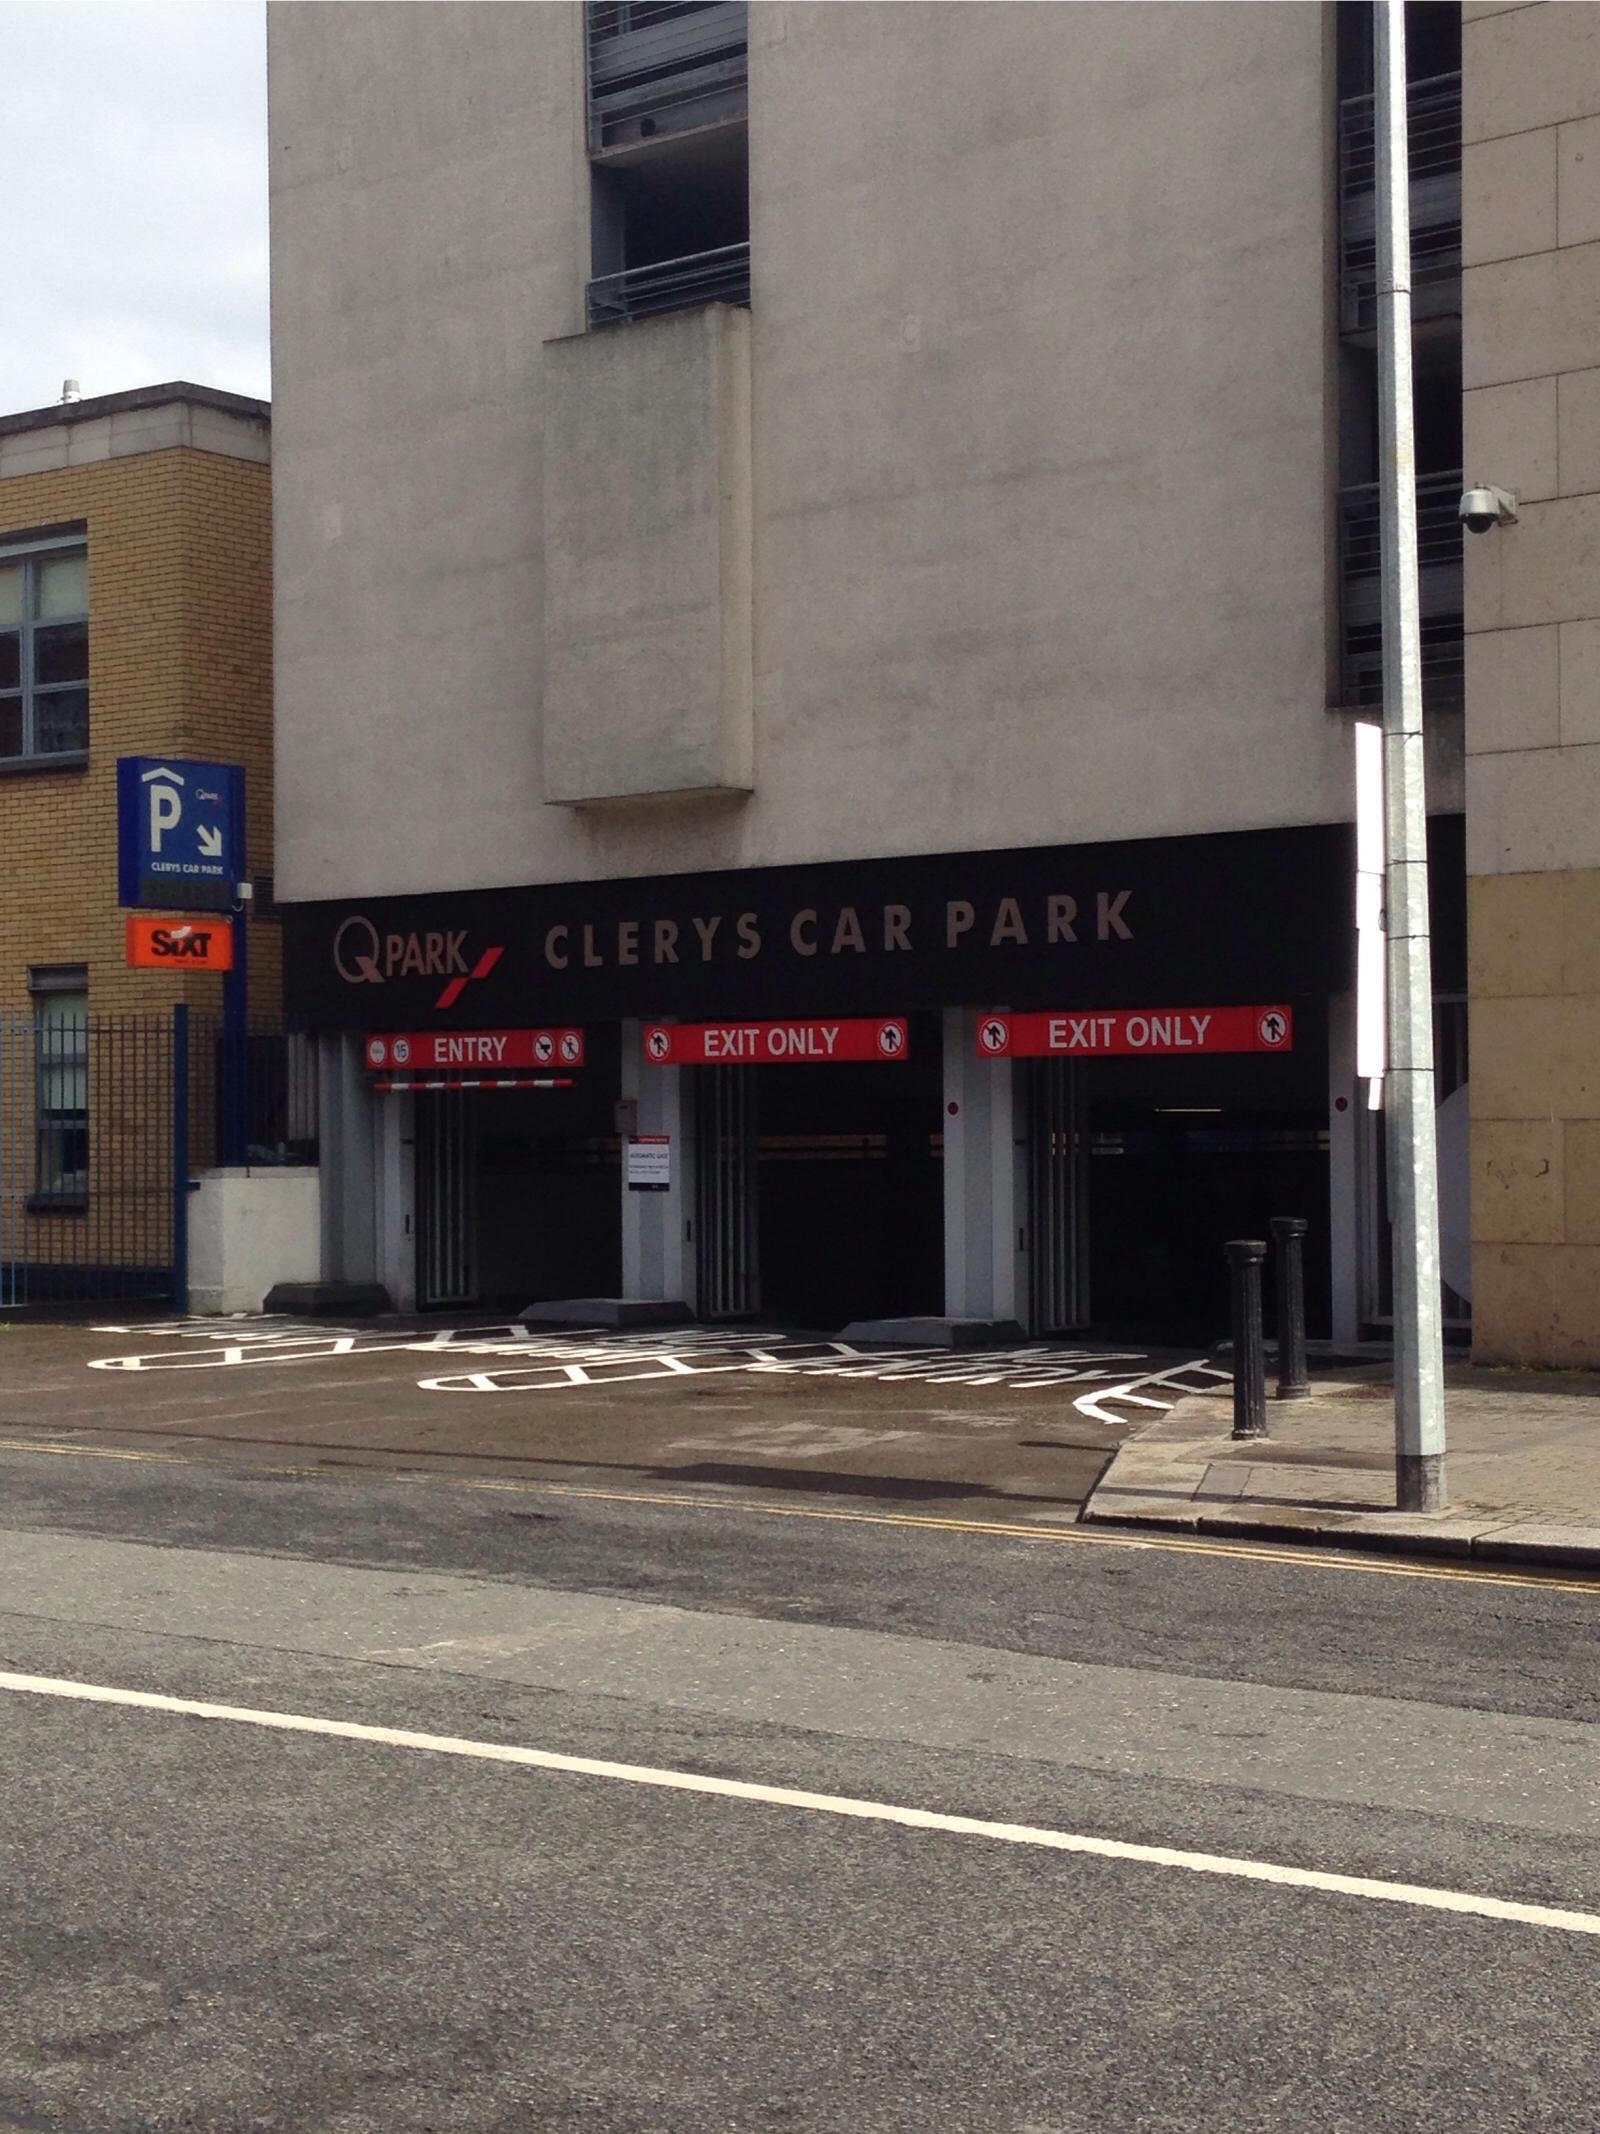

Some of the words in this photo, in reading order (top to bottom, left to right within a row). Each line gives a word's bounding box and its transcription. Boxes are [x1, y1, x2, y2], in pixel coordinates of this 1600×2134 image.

[151, 784, 182, 852] P
[183, 864, 200, 874] CAR
[201, 865, 224, 875] PARK
[545, 911, 761, 970] CLERYS
[789, 903, 914, 957] CAR
[946, 890, 1135, 949] PARK
[703, 1028, 765, 1057] EXIT
[768, 1026, 839, 1055] ONLY
[1048, 1018, 1117, 1048] EXIT
[1125, 1015, 1212, 1047] ONLY
[396, 1043, 408, 1059] 15
[434, 1036, 507, 1062] ENTRY
[929, 1347, 1149, 1364] NO
[747, 1356, 1152, 1388] ENTRY
